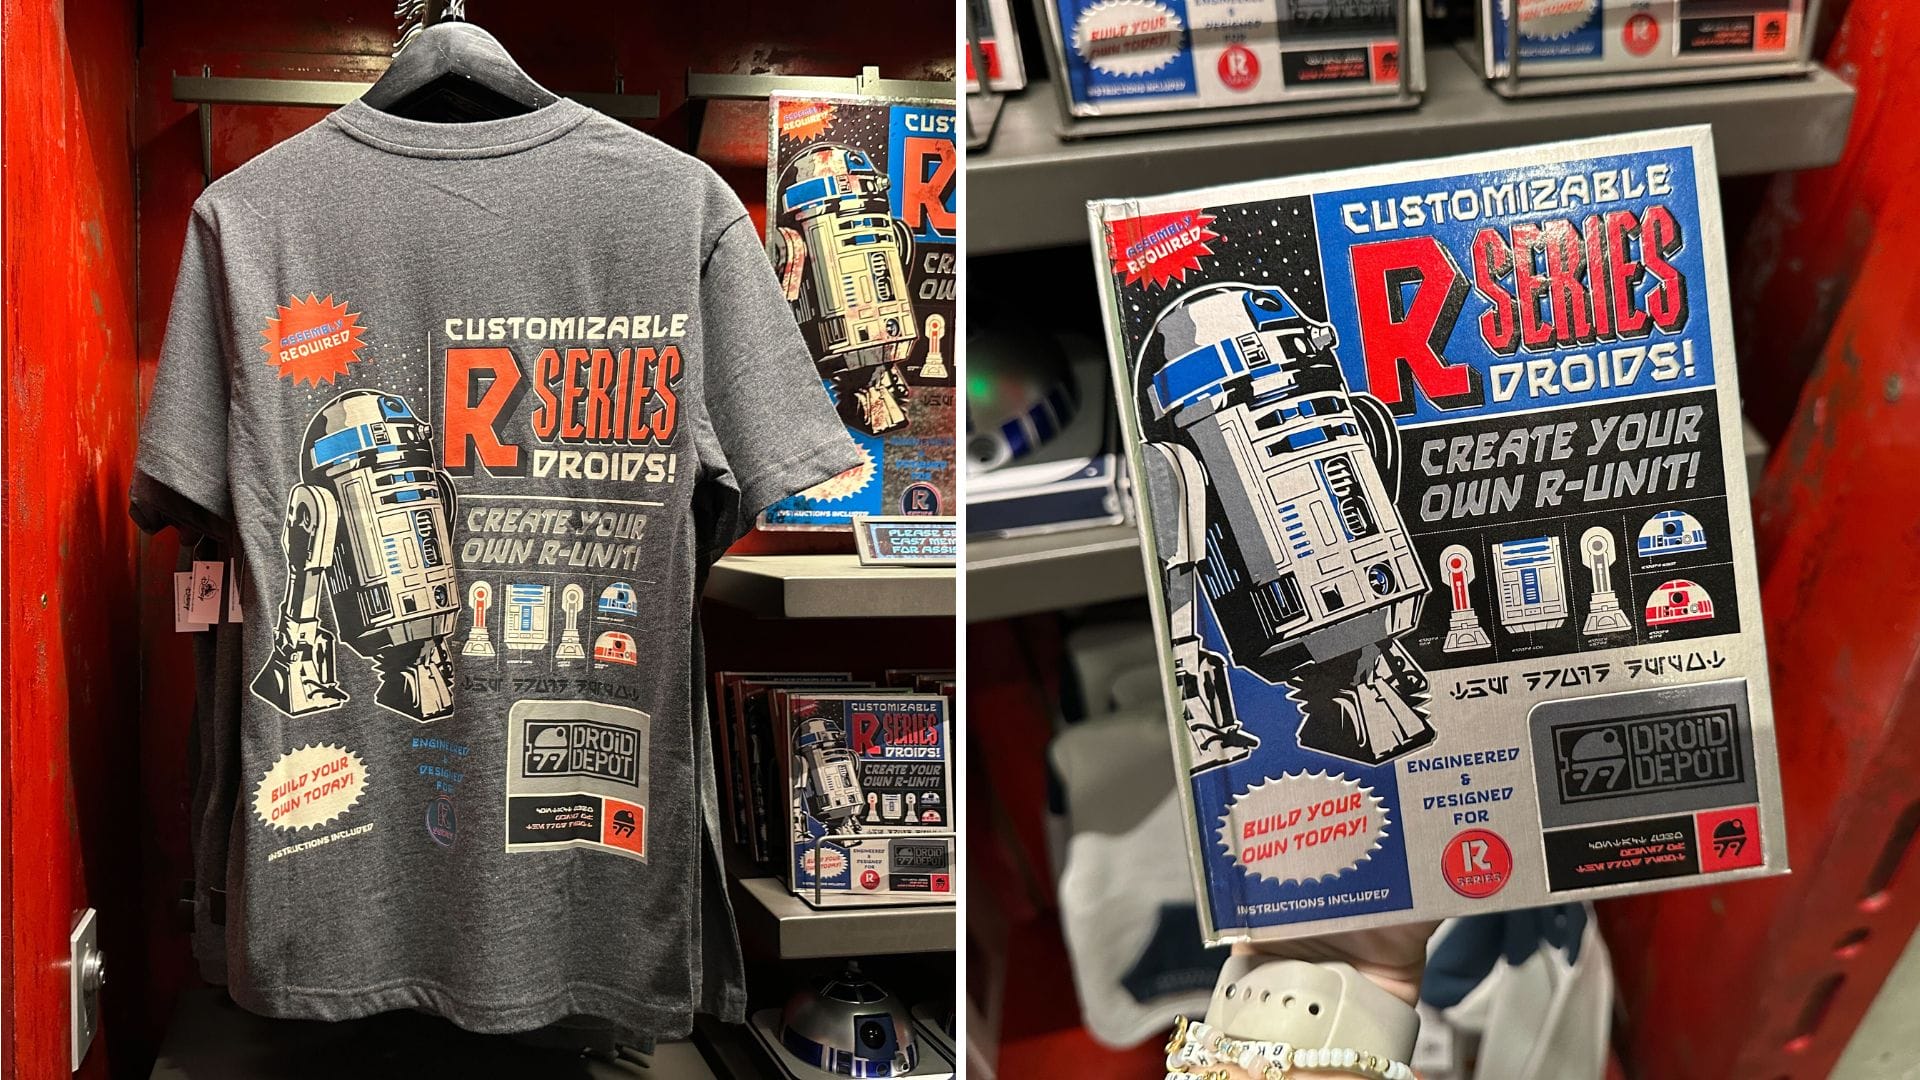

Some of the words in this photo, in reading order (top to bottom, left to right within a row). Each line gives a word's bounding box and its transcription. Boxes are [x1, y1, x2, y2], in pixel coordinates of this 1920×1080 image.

[1132, 16, 1168, 35] YOUR
[1342, 164, 1673, 234] CUSTOMIZABLE
[1126, 215, 1192, 258] ASSEMBLY
[1127, 226, 1201, 275] REQUIRED
[924, 252, 956, 274] CR
[1471, 205, 1688, 357] SERIES
[281, 319, 344, 347] ASSEMBLY
[445, 313, 689, 341] CUSTOMIZABLE
[1350, 235, 1484, 416] R
[280, 330, 350, 363] REQUIRED
[1490, 338, 1694, 402] DROIDS!
[443, 346, 530, 478] R
[532, 345, 685, 447] SERIES
[1420, 422, 1578, 477] CREATE
[1586, 404, 1704, 456] YOUR
[532, 449, 677, 483] DROIDS!
[1420, 474, 1525, 522] OWN
[1535, 451, 1700, 508] R-UNIT!
[467, 506, 573, 534] CREATE
[575, 510, 648, 540] YOUR
[889, 529, 941, 537] PLEASE
[461, 537, 535, 564] OWN
[538, 540, 642, 571] R-UNIT!
[891, 537, 926, 545] CAST
[892, 546, 920, 554] FOR
[851, 703, 937, 711] CUSTOMIZABLE
[851, 712, 882, 758] R
[882, 712, 940, 747] SERIES
[571, 748, 633, 779] DEPOT
[864, 764, 907, 775] CREATE
[909, 764, 941, 775] YOUR
[885, 747, 940, 758] DROIDS!
[1407, 748, 1520, 773] ENGINEERED
[1636, 746, 1728, 786] DEPOT
[271, 773, 308, 804] BUILD
[312, 756, 349, 782] YOUR
[863, 776, 890, 787] OWN
[895, 777, 940, 787] R-UNIT!
[1461, 773, 1471, 785] &
[271, 800, 301, 821] OWN
[304, 773, 354, 804] TODAY!
[1423, 787, 1514, 810] DESIGNED
[1242, 808, 1303, 840] BUILD
[1307, 791, 1362, 822] YOUR
[1453, 809, 1490, 825] FOR
[268, 834, 330, 861] INSTRUCTIONS
[331, 822, 374, 842] INCLUDED
[1242, 838, 1288, 864] OWN
[1294, 815, 1368, 851] TODAY!
[1462, 838, 1492, 872] R
[915, 857, 942, 866] DEPOT
[1456, 872, 1502, 886] SERIES
[1236, 896, 1326, 916] INSTRUCTIONS
[1328, 888, 1390, 906] INCLUDED
